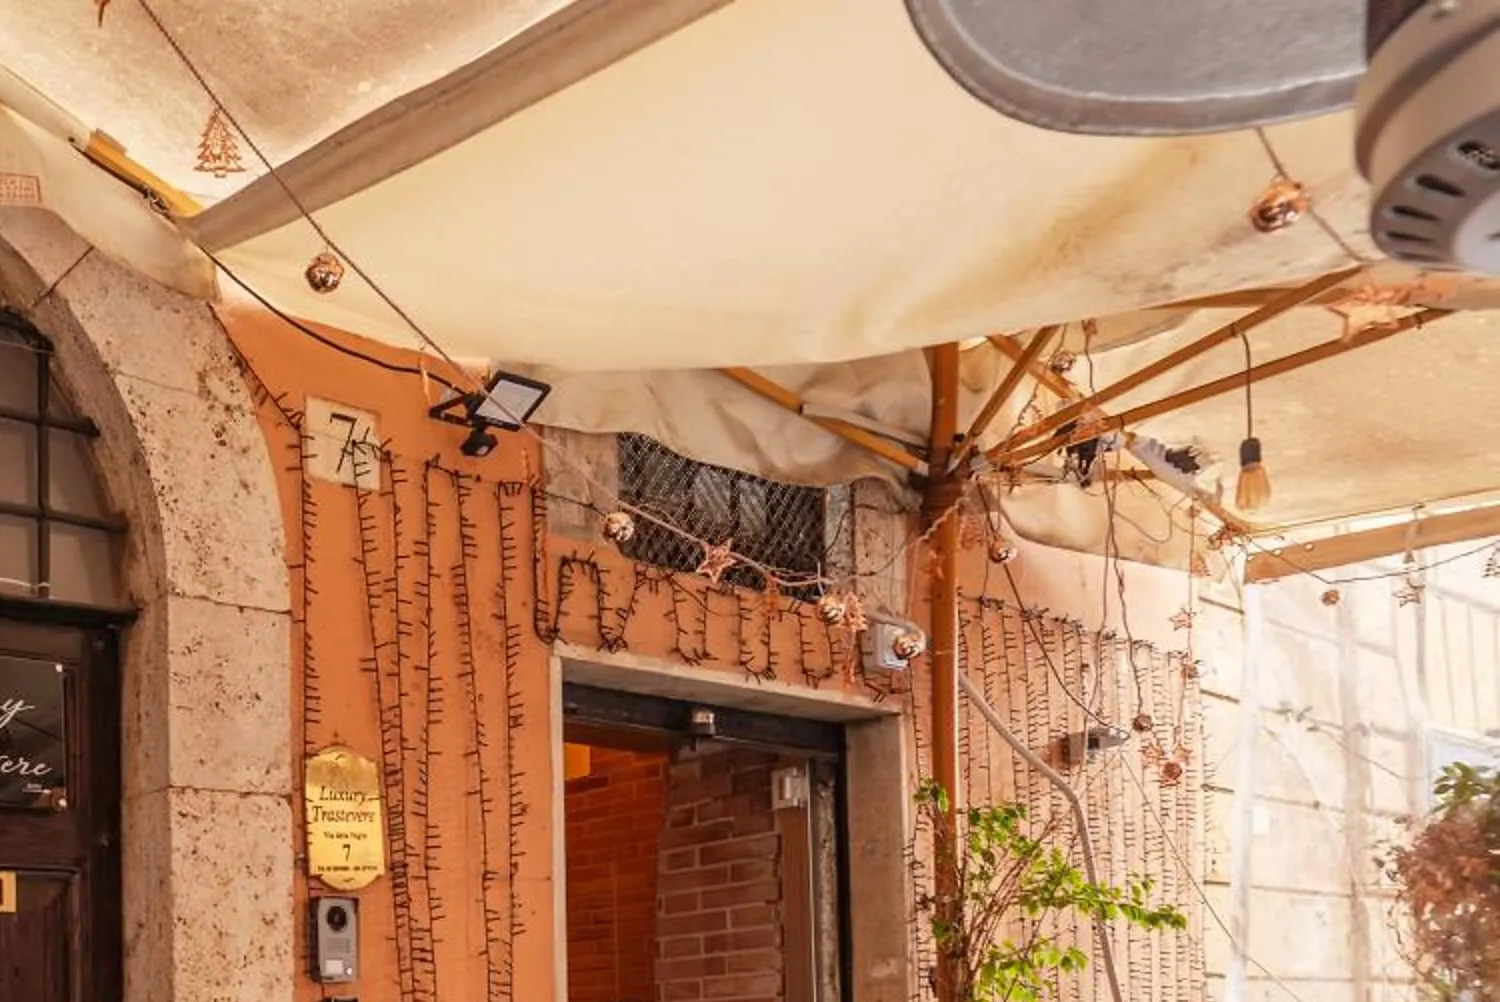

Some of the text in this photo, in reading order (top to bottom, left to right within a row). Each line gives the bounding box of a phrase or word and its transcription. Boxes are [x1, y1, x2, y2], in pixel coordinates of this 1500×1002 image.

[329, 412, 357, 473] 7
[319, 785, 366, 805] Luxury
[342, 843, 350, 861] 7
